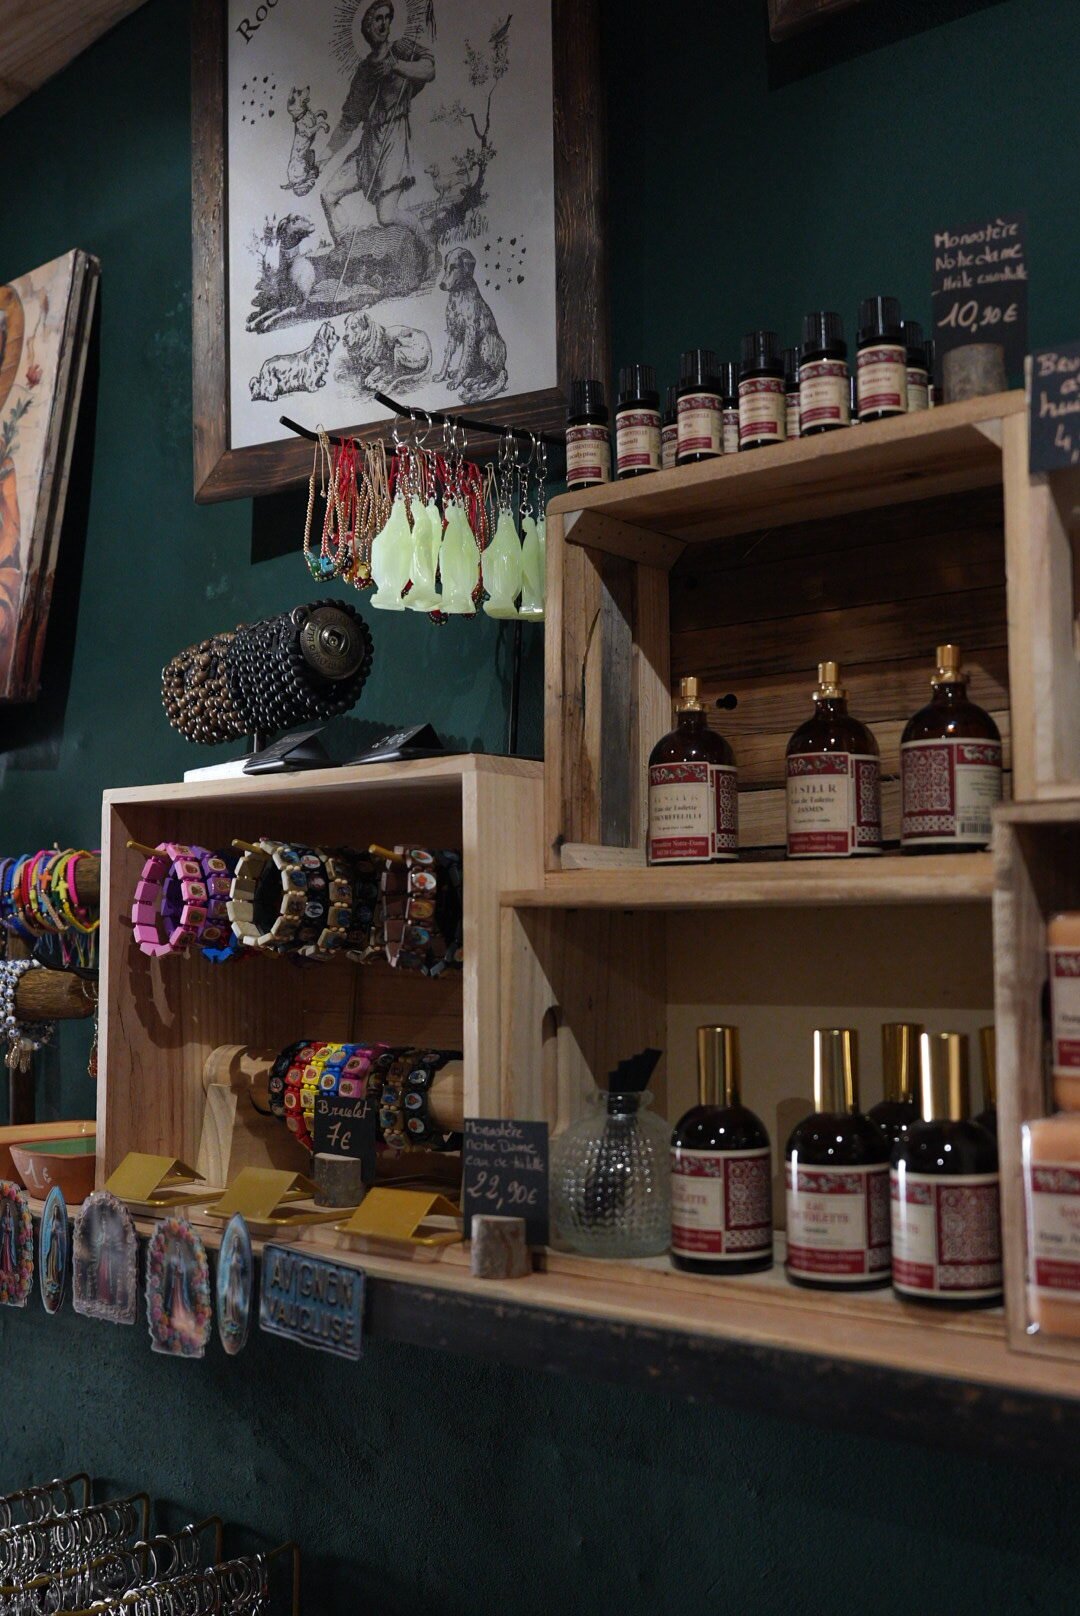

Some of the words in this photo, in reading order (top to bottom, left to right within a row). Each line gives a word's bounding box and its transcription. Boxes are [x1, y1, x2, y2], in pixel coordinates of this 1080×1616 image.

[316, 1099, 372, 1119] Bracelet
[326, 1121, 352, 1150] 7€
[466, 1171, 538, 1211] 22,90€
[266, 1298, 354, 1347] VAUCLUSE
